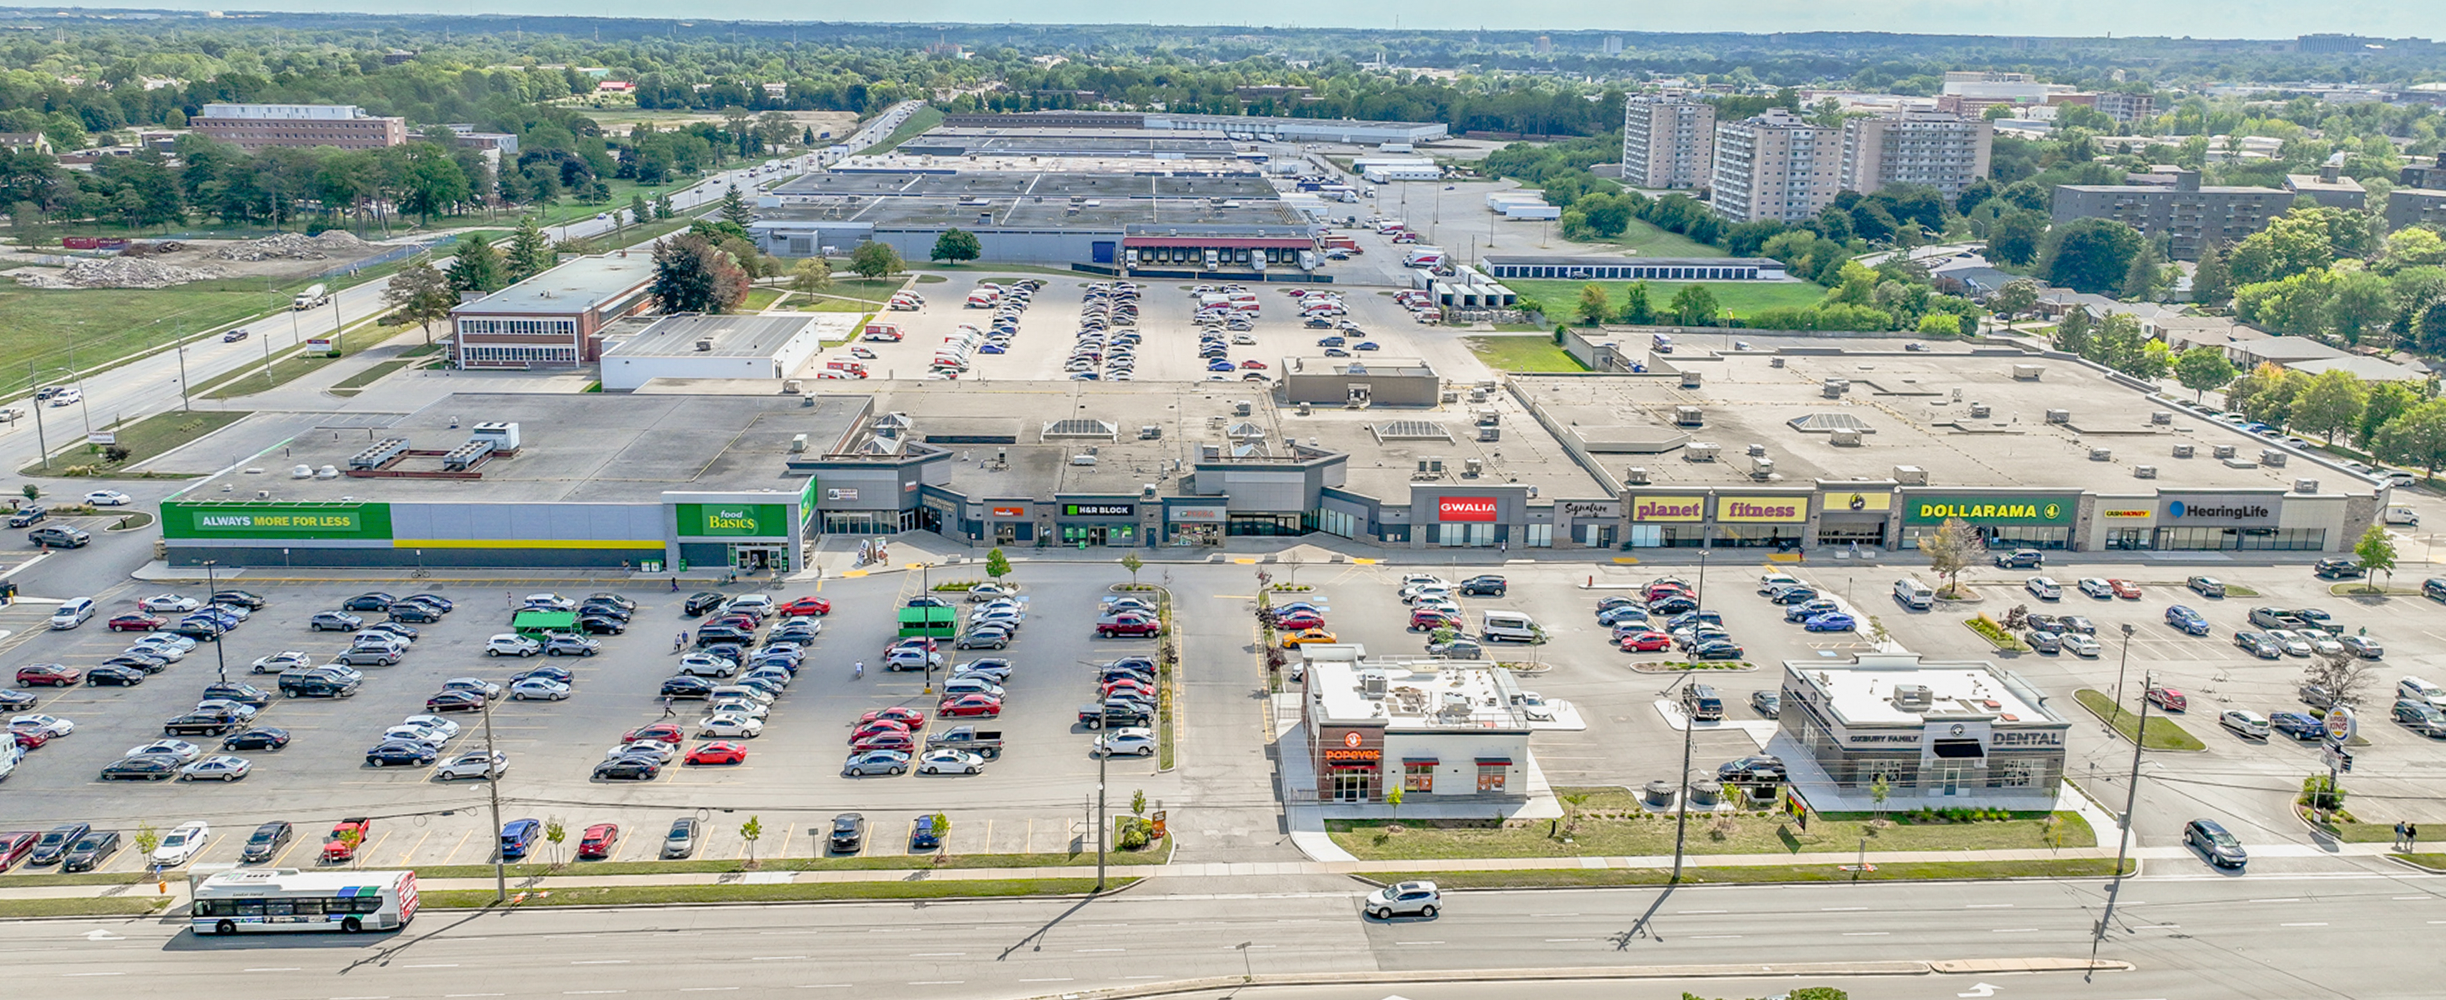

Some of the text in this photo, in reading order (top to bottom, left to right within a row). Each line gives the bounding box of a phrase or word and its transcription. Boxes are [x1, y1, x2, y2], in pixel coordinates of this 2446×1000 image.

[1078, 506, 1129, 514] H&R BLOCK
[1440, 502, 1497, 512] GWALIA
[1564, 502, 1608, 516] Signature
[1637, 501, 1796, 520] planet fitness
[1920, 504, 2037, 518] DOLLARAMA
[2187, 505, 2269, 519] HearingLife
[720, 509, 744, 519] food
[1186, 510, 1215, 518] PIZZA
[202, 516, 351, 527] ALWAYS MORE FOR LESS
[709, 515, 755, 529] Basics
[2329, 722, 2348, 731] KING
[1850, 732, 2061, 746] OXBURY FAMILY DENTAL
